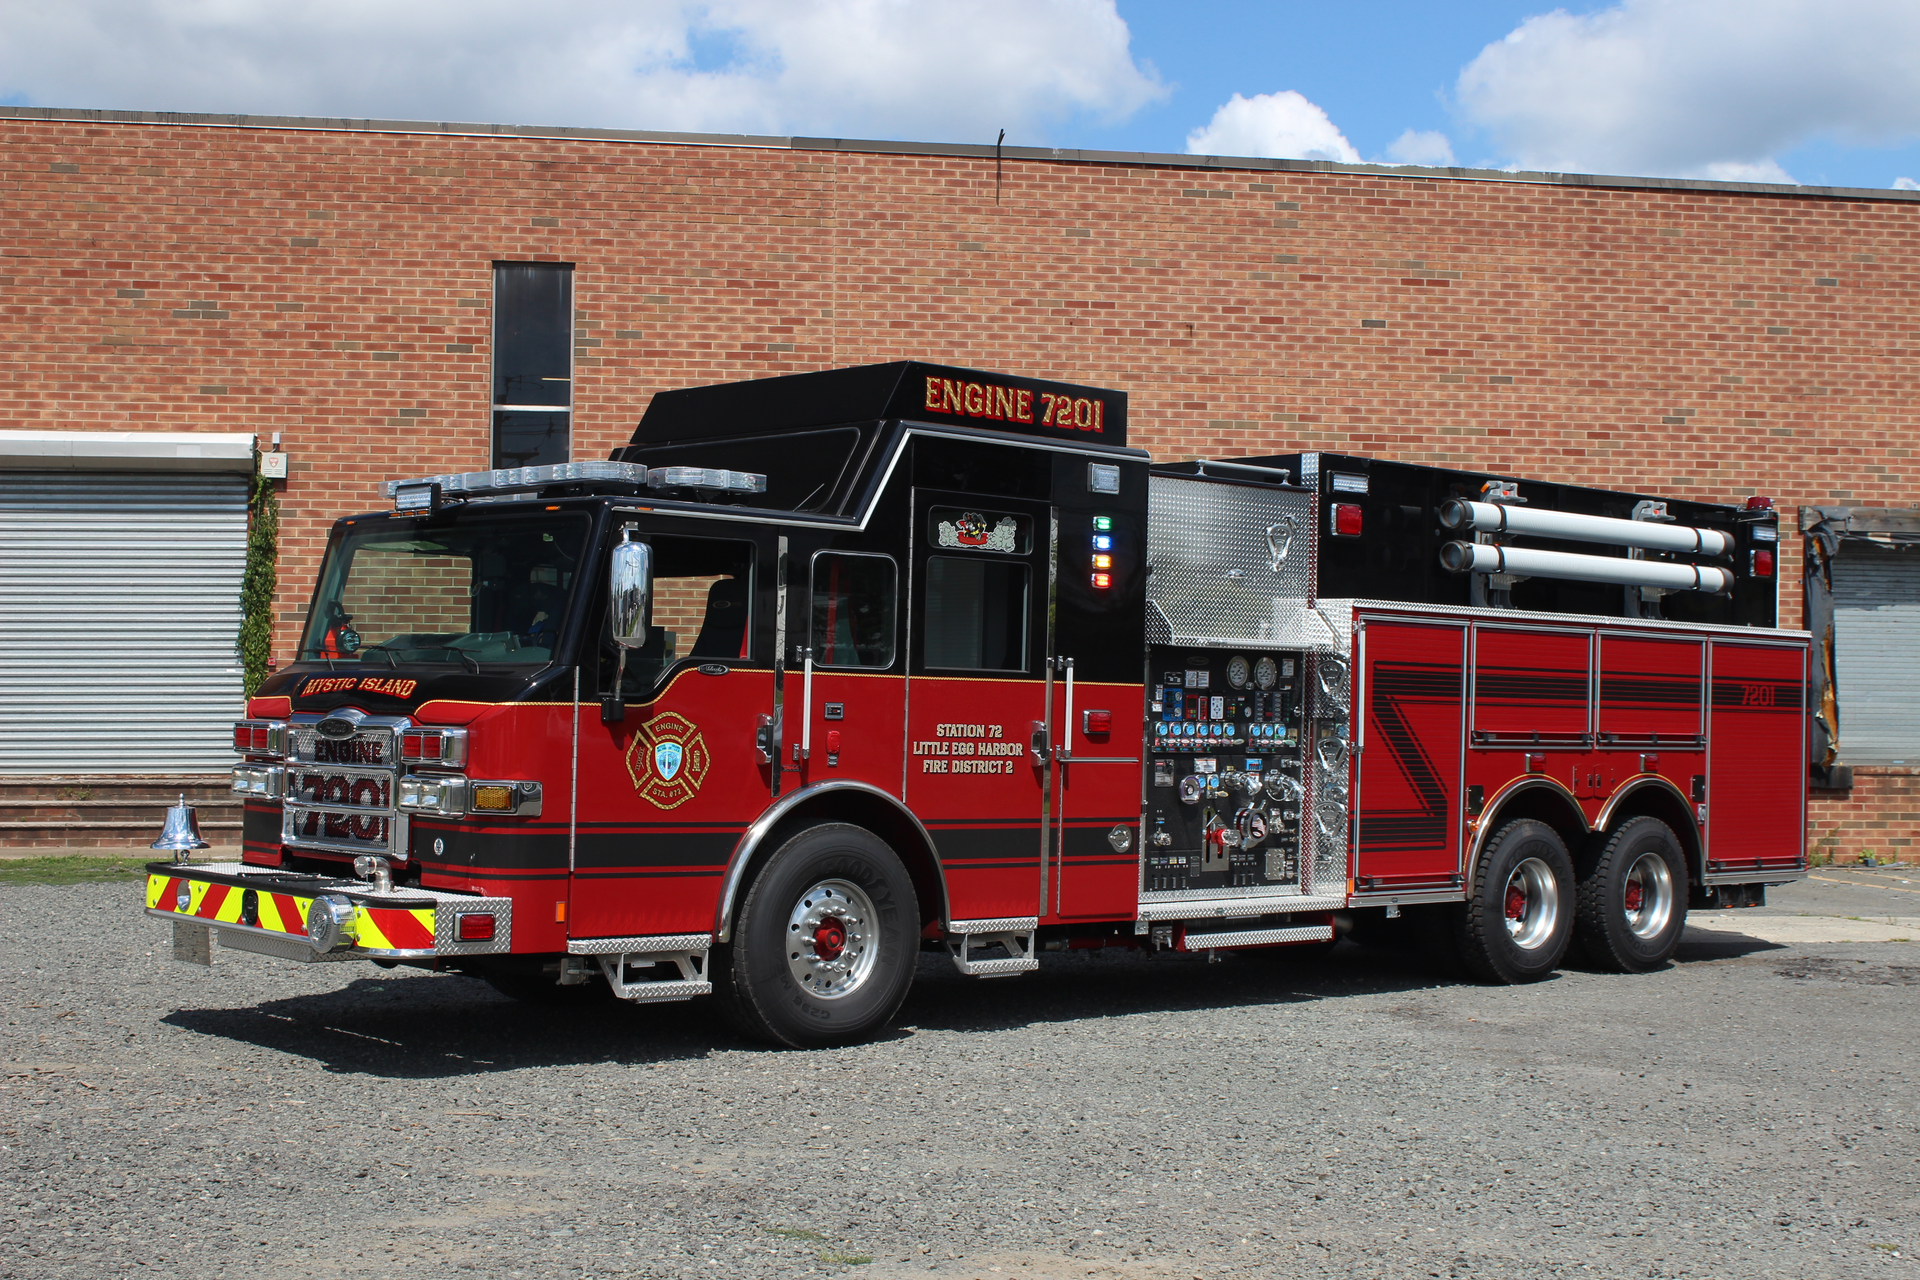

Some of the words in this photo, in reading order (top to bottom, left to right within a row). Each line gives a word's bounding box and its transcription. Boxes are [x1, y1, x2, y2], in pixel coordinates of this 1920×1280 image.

[925, 375, 1034, 424] ENGINE
[1040, 392, 1104, 433] 7201
[300, 678, 357, 698] MYSTIC
[357, 678, 417, 700] ISLAND
[1741, 684, 1775, 706] 7201
[654, 722, 684, 733] ENGINE
[936, 723, 985, 738] STATION
[988, 725, 1003, 738] 72
[314, 740, 383, 764] ENGINE
[913, 741, 950, 755] LITTLE
[951, 742, 975, 756] EGG
[977, 743, 1024, 756] HARBOR
[922, 759, 949, 773] FIRE
[951, 760, 1004, 774] DISTRICT
[1005, 761, 1014, 774] 2
[819, 857, 901, 966] GOODYEAR
[791, 995, 831, 1020] G296
